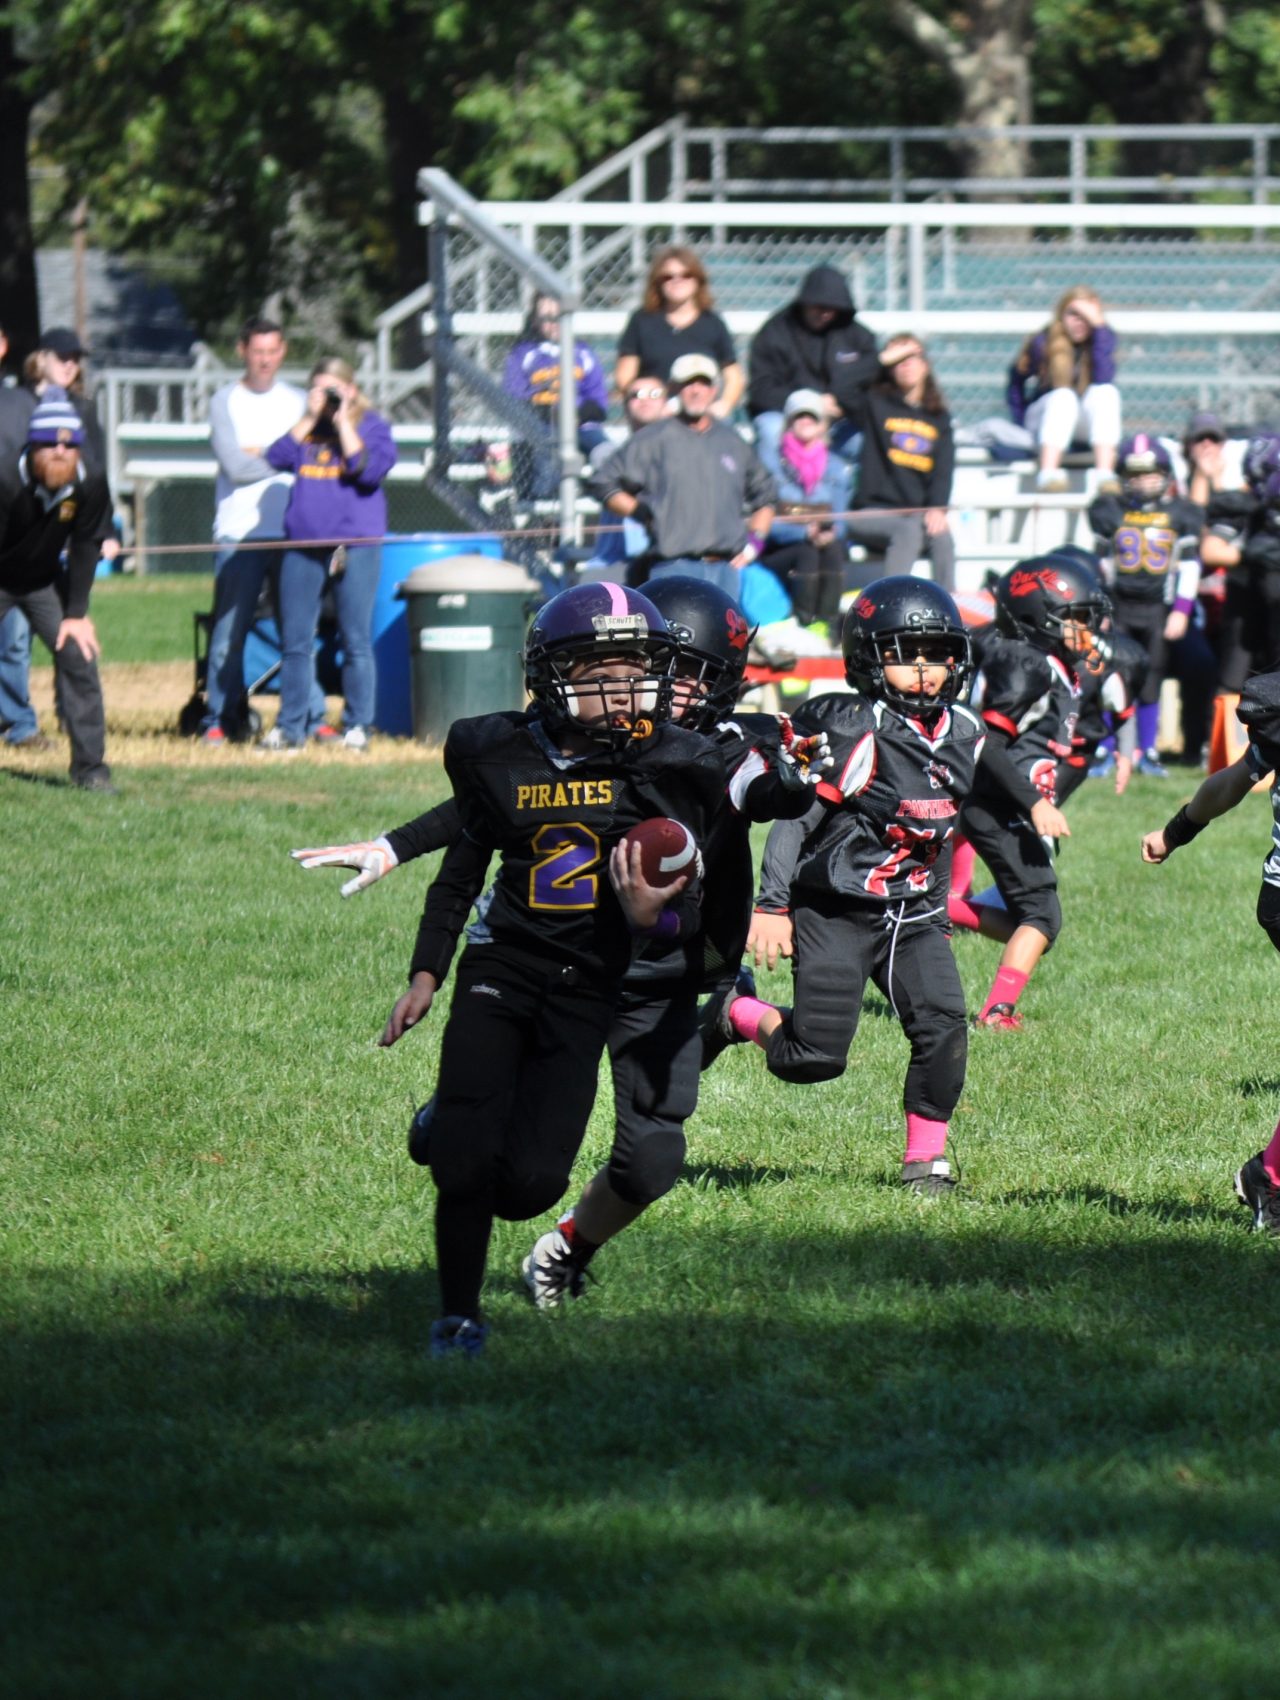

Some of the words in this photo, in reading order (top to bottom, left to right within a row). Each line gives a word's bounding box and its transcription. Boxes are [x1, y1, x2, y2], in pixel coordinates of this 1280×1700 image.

[1114, 527, 1178, 575] 85
[607, 616, 632, 625] SCHUTT
[516, 779, 613, 809] PIRATES
[528, 822, 600, 910] 2
